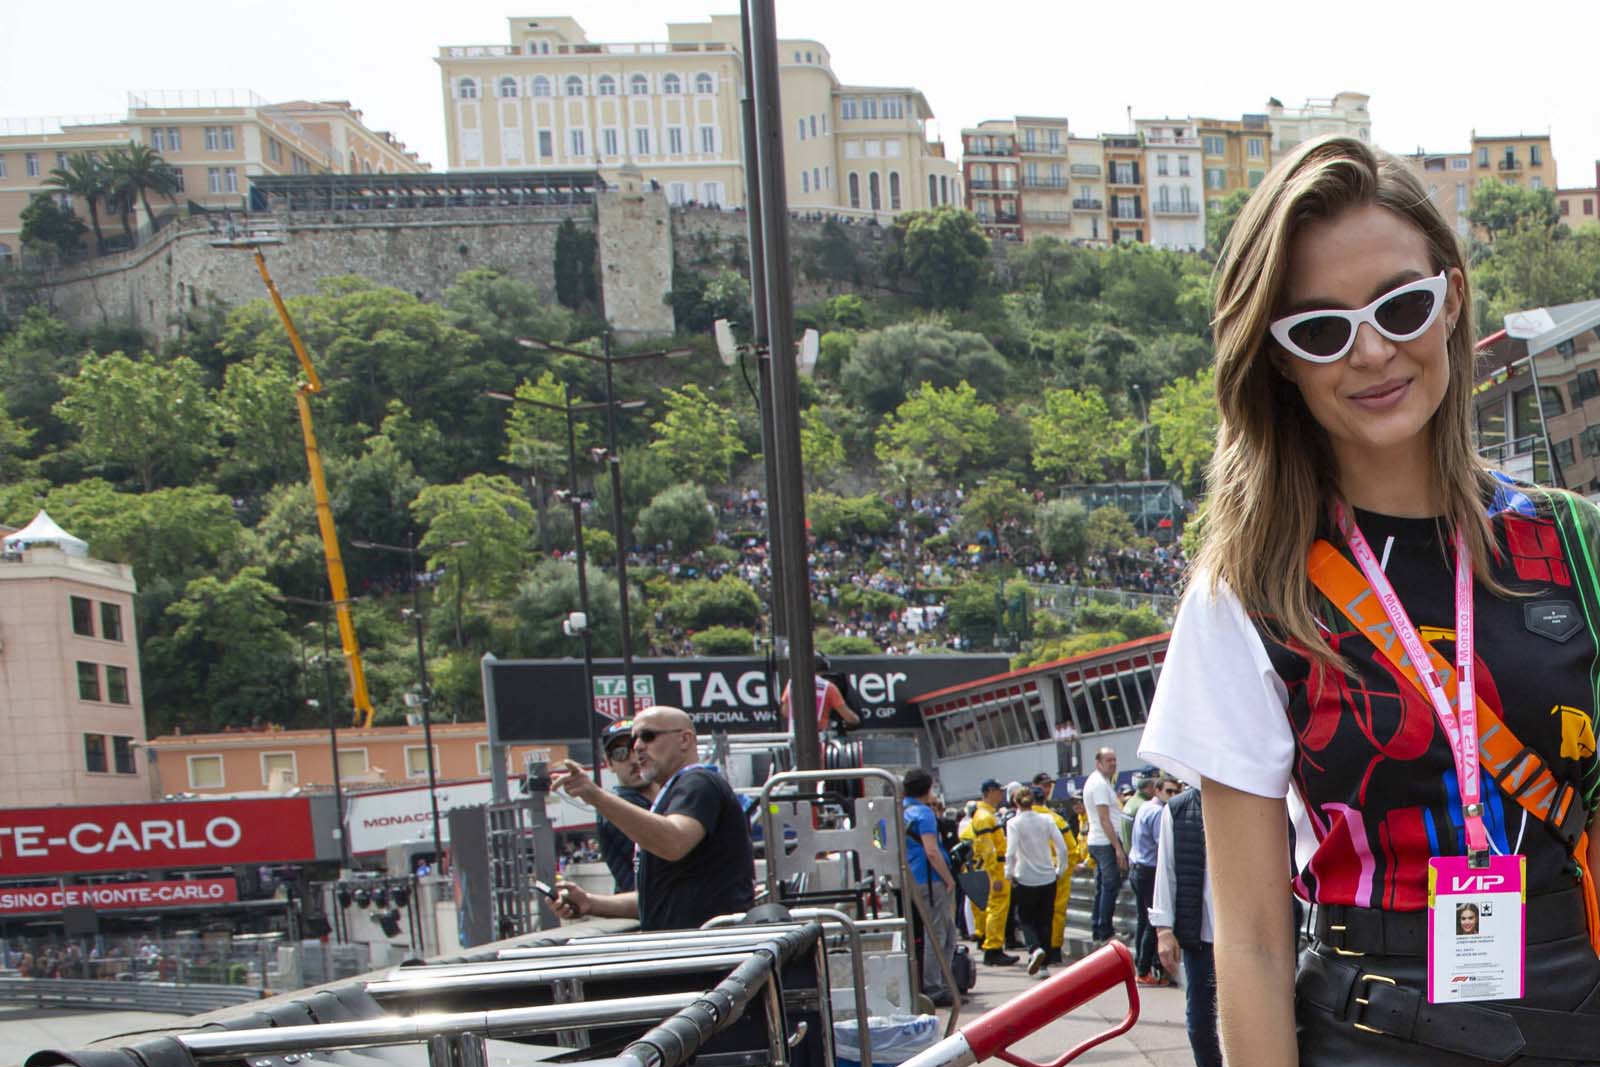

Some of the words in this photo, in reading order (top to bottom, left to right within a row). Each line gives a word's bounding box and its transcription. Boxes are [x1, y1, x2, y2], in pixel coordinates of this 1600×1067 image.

[1384, 593, 1413, 640] Monaco
[1460, 613, 1469, 662] Monaco
[668, 671, 769, 708] TAG
[689, 711, 749, 723] OFFICIAL
[1464, 736, 1476, 779] VIP
[0, 892, 48, 908] SINO
[52, 891, 79, 906] DE
[83, 883, 225, 905] MONTE-CARLO
[1452, 875, 1505, 892] VIP
